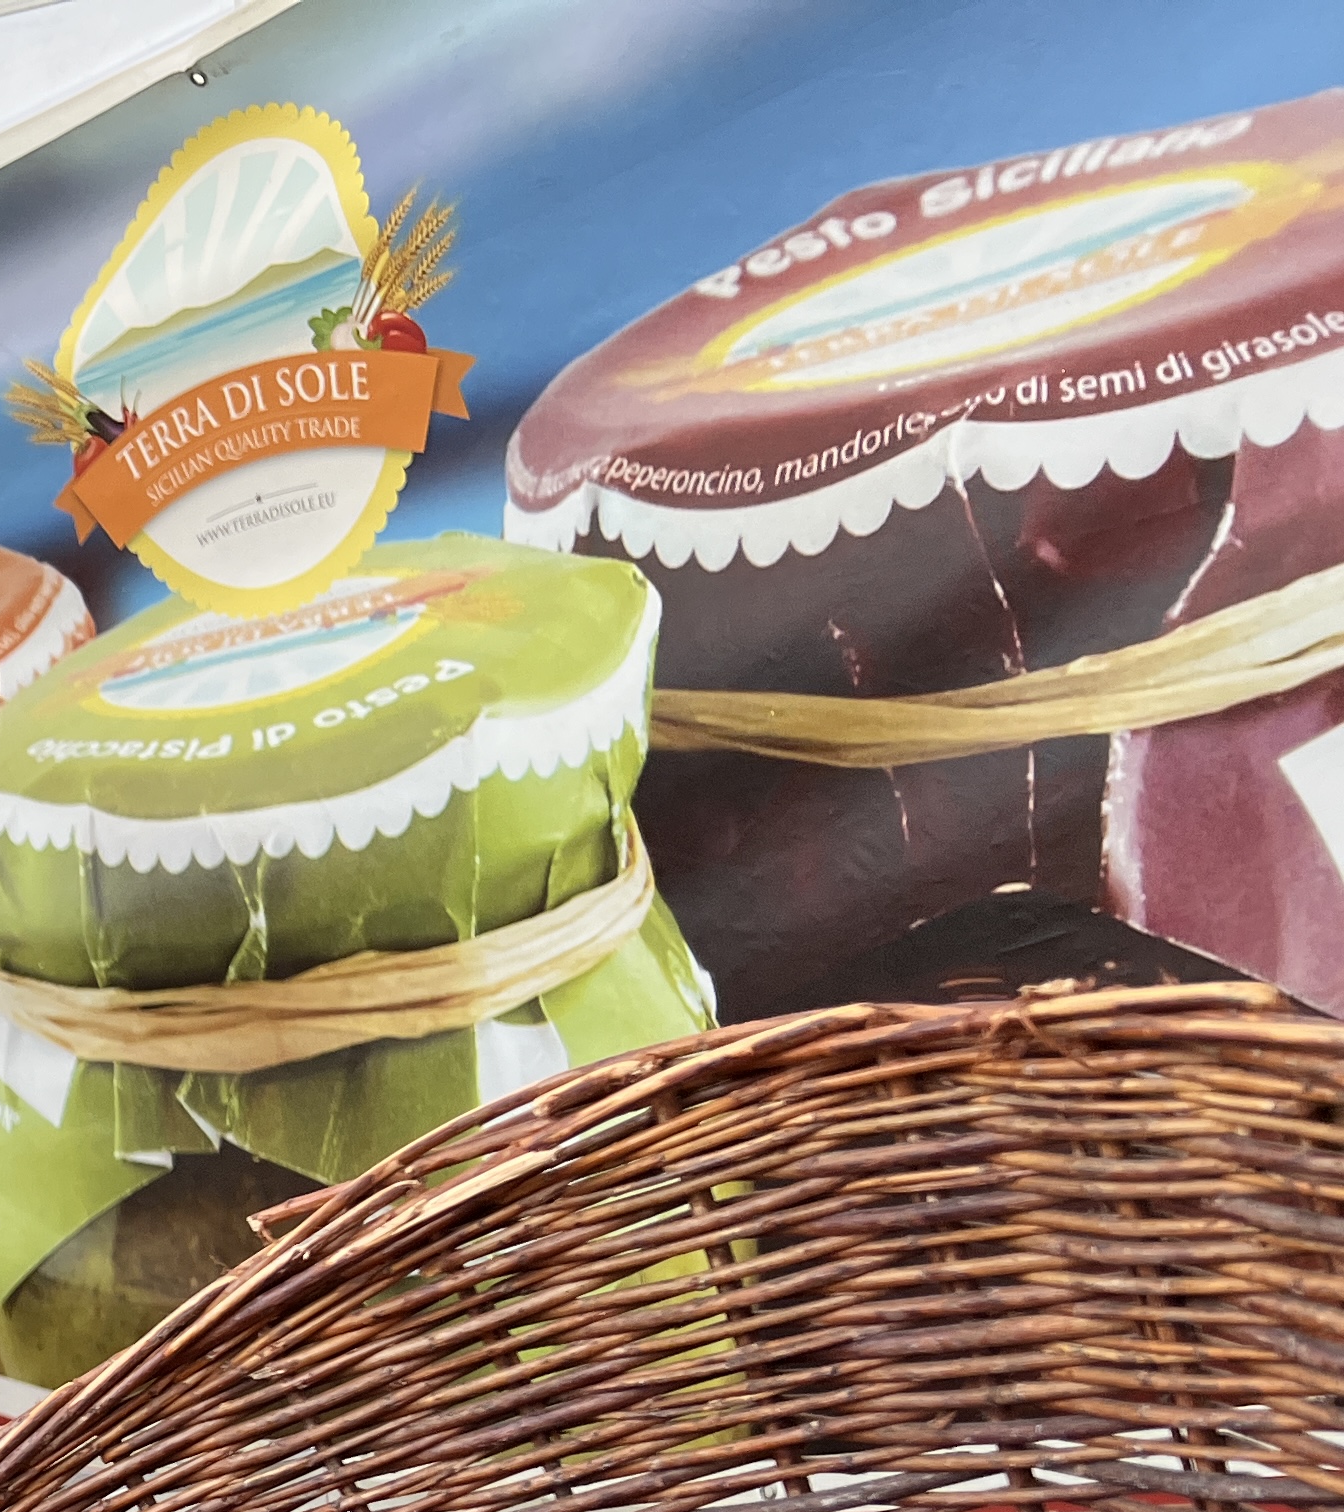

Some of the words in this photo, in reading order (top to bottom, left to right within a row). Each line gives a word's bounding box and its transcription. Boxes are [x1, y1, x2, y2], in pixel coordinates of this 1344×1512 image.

[690, 210, 898, 300] Pesto
[919, 114, 1255, 218] Siciliano
[115, 396, 221, 480] TERRA
[221, 375, 268, 422] DI
[275, 361, 371, 407] SOLE
[604, 453, 765, 495] peperoncino,
[1015, 374, 1050, 406] di
[1059, 360, 1148, 402] semi
[1155, 351, 1195, 385] di
[1201, 310, 1344, 381] girasole
[145, 446, 216, 508] SICILIAN
[214, 420, 292, 461] QUALITY
[297, 415, 362, 439] TRADE
[252, 721, 296, 752] di
[312, 658, 476, 728] Pesto
